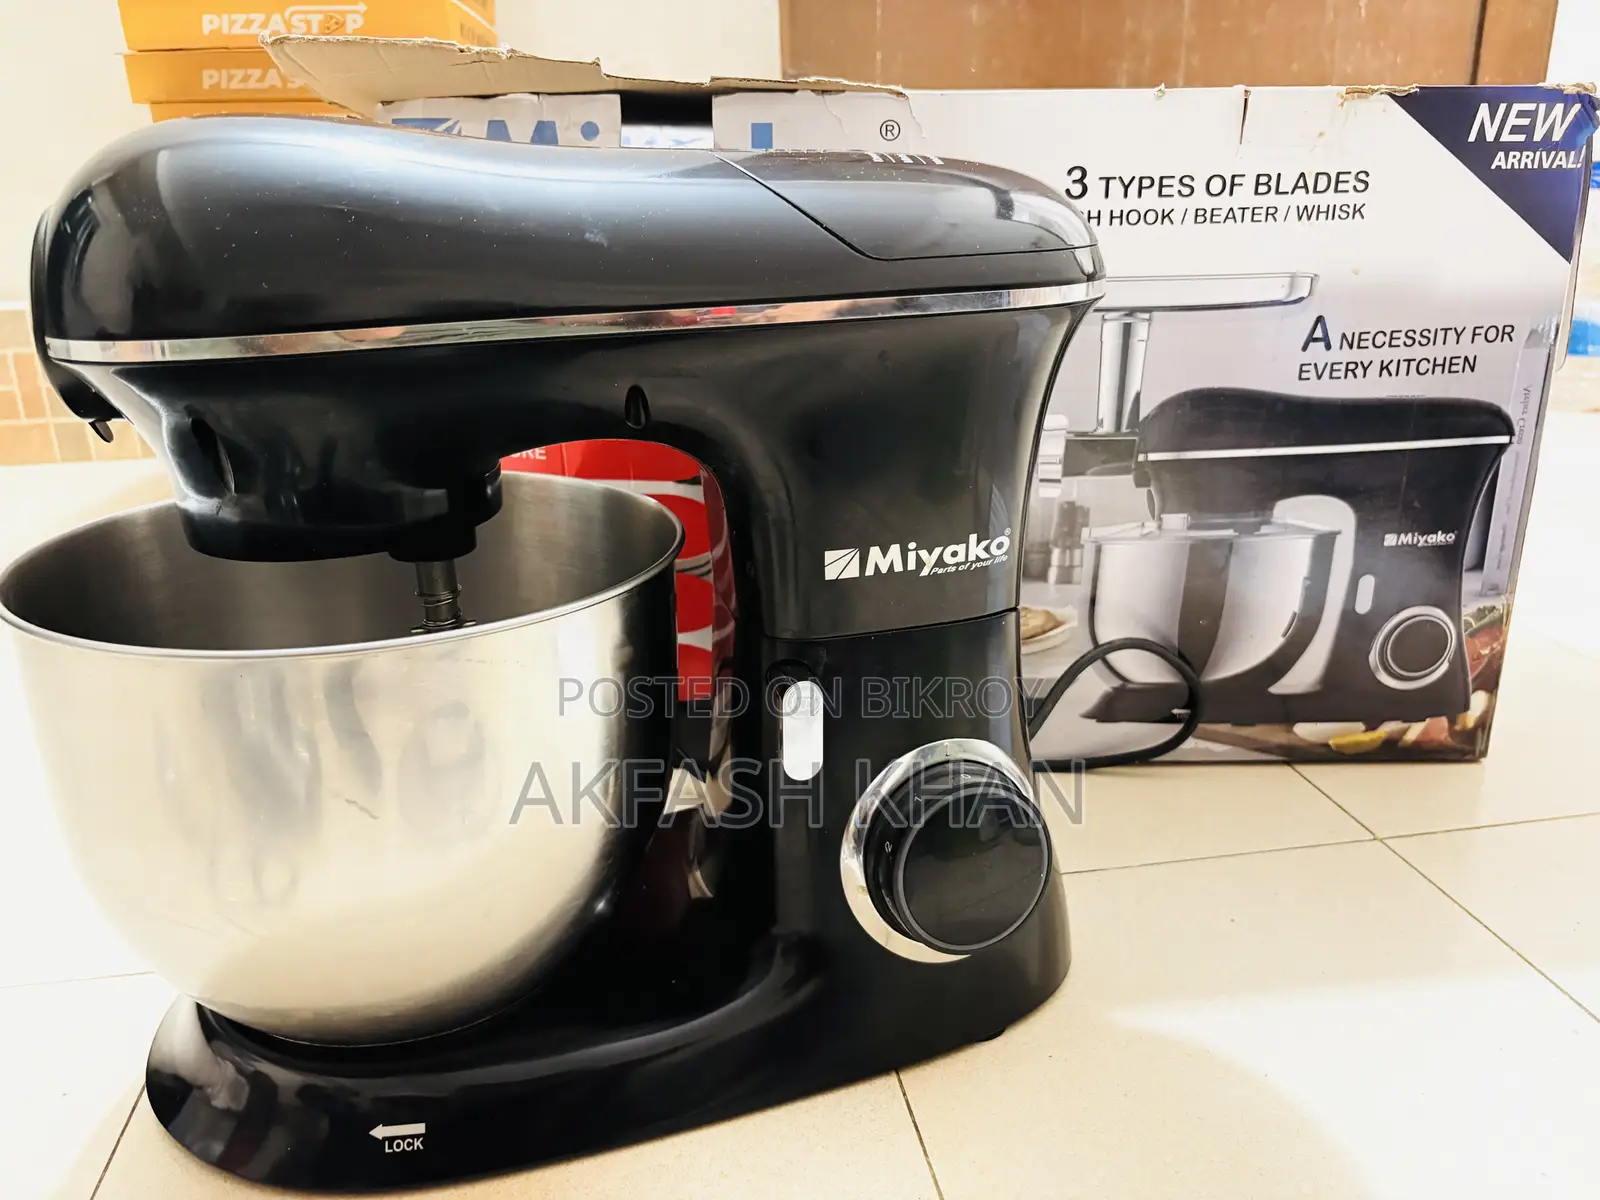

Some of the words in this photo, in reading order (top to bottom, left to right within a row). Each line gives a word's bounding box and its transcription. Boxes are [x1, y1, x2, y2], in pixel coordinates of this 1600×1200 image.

[1467, 102, 1582, 142] NEW
[1490, 145, 1587, 170] ARRIVAL!
[1065, 165, 1089, 200] 3
[1098, 175, 1196, 200] TYPES
[1205, 173, 1247, 198] OF
[1254, 170, 1371, 197] BLADES
[1108, 208, 1175, 227] HOOK
[1193, 205, 1279, 225] BEATER
[1296, 203, 1366, 222] WHISK
[1301, 314, 1332, 353] A
[1339, 326, 1467, 351] NECESSITY
[1470, 324, 1516, 345] FOR
[1298, 360, 1374, 382] EVERY
[1378, 355, 1478, 378] KITCHEN
[1397, 529, 1456, 548] Miyako
[864, 533, 1011, 577] Miyako
[930, 565, 958, 576] Parts
[958, 562, 971, 571] of
[970, 558, 994, 571] your
[993, 554, 1009, 565] life
[384, 1137, 424, 1154] LOCK
